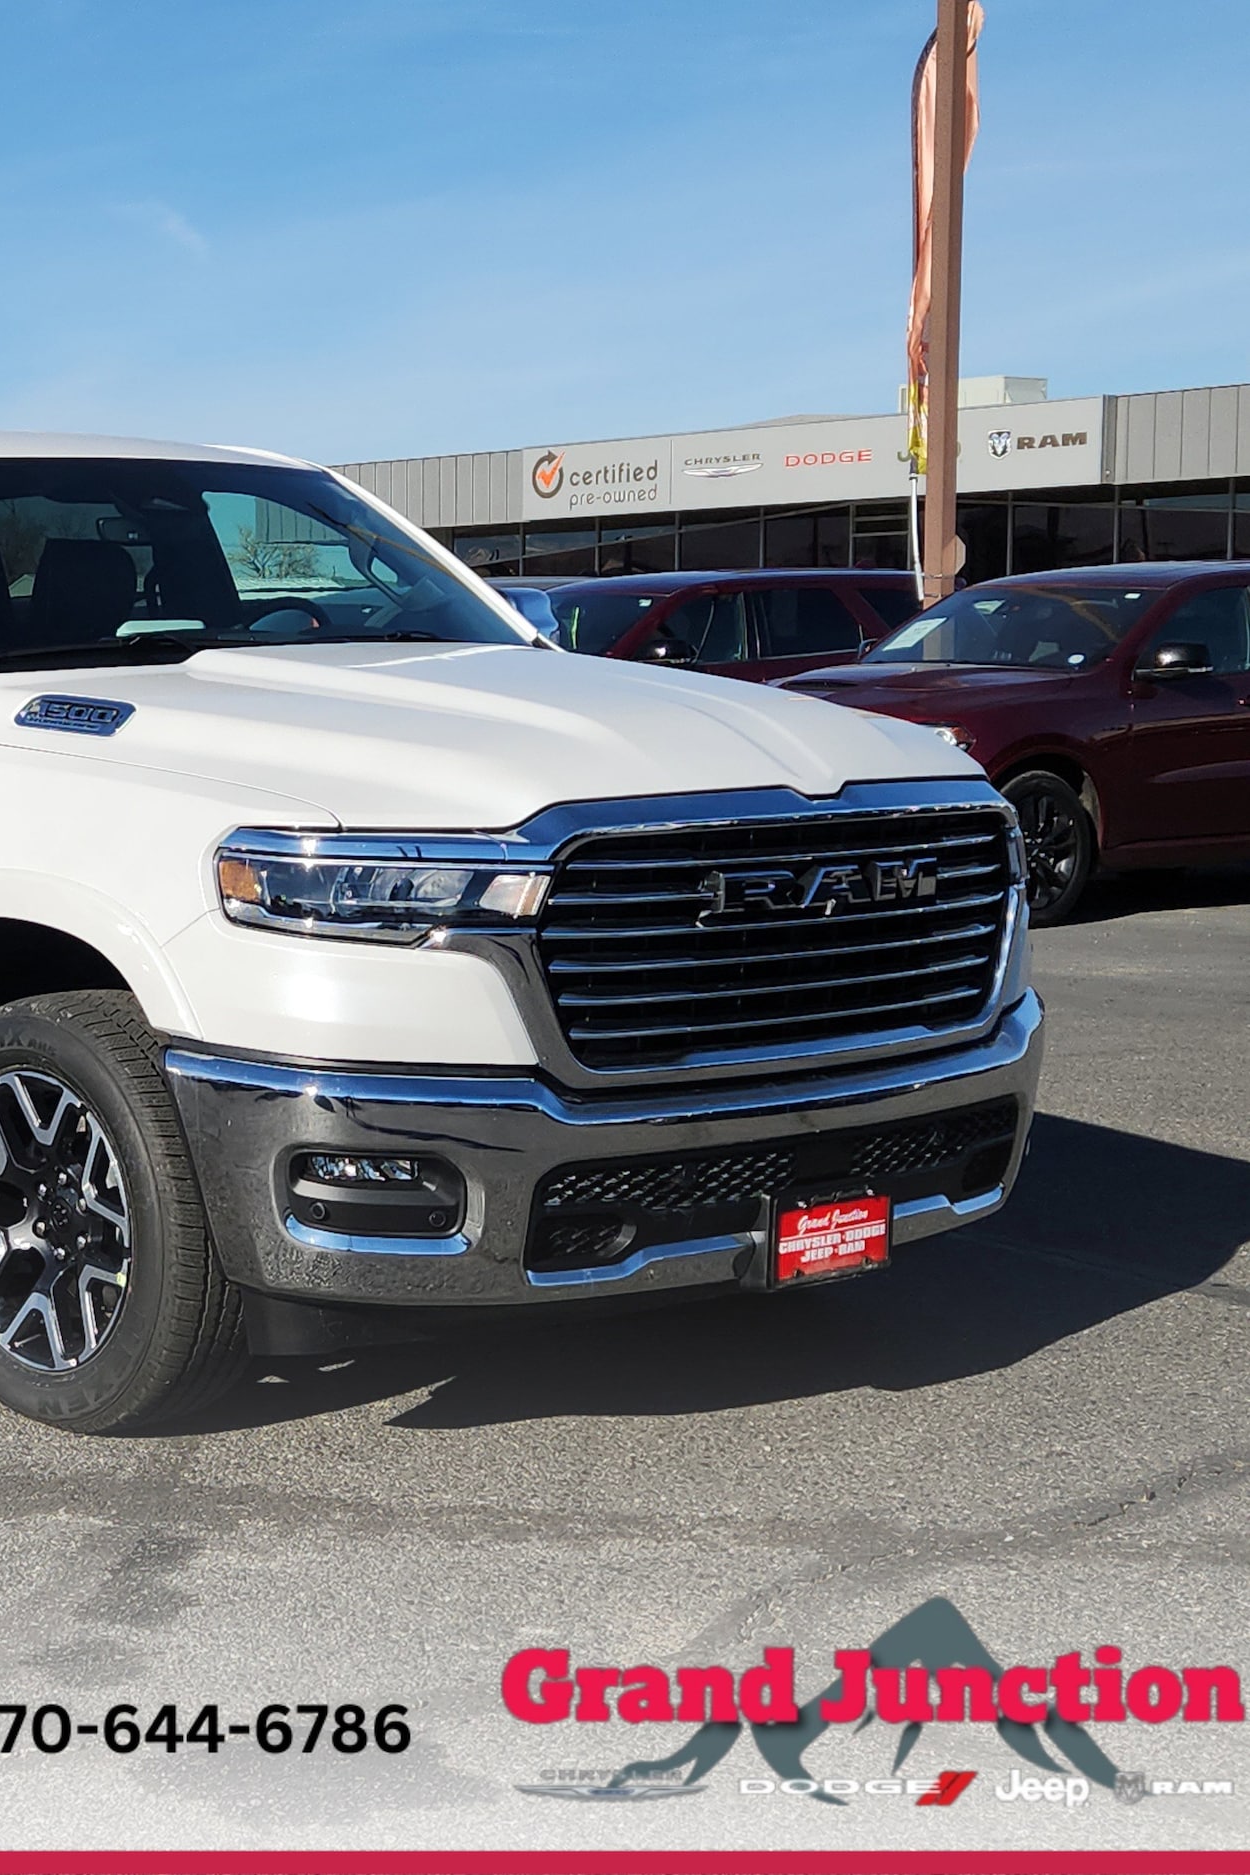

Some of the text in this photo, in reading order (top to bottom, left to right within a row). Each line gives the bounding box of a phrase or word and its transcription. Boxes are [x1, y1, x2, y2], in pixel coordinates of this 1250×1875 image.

[1017, 432, 1088, 450] RAM
[684, 452, 762, 467] CHRYSLER
[785, 448, 874, 468] DODGE
[569, 459, 659, 488] certified
[568, 483, 659, 511] pre-owned
[702, 858, 937, 912] RAM
[797, 1208, 869, 1236] Grand Junction
[778, 1223, 886, 1255] CHRYSLER DODGE
[800, 1240, 865, 1263] JEEP RAM
